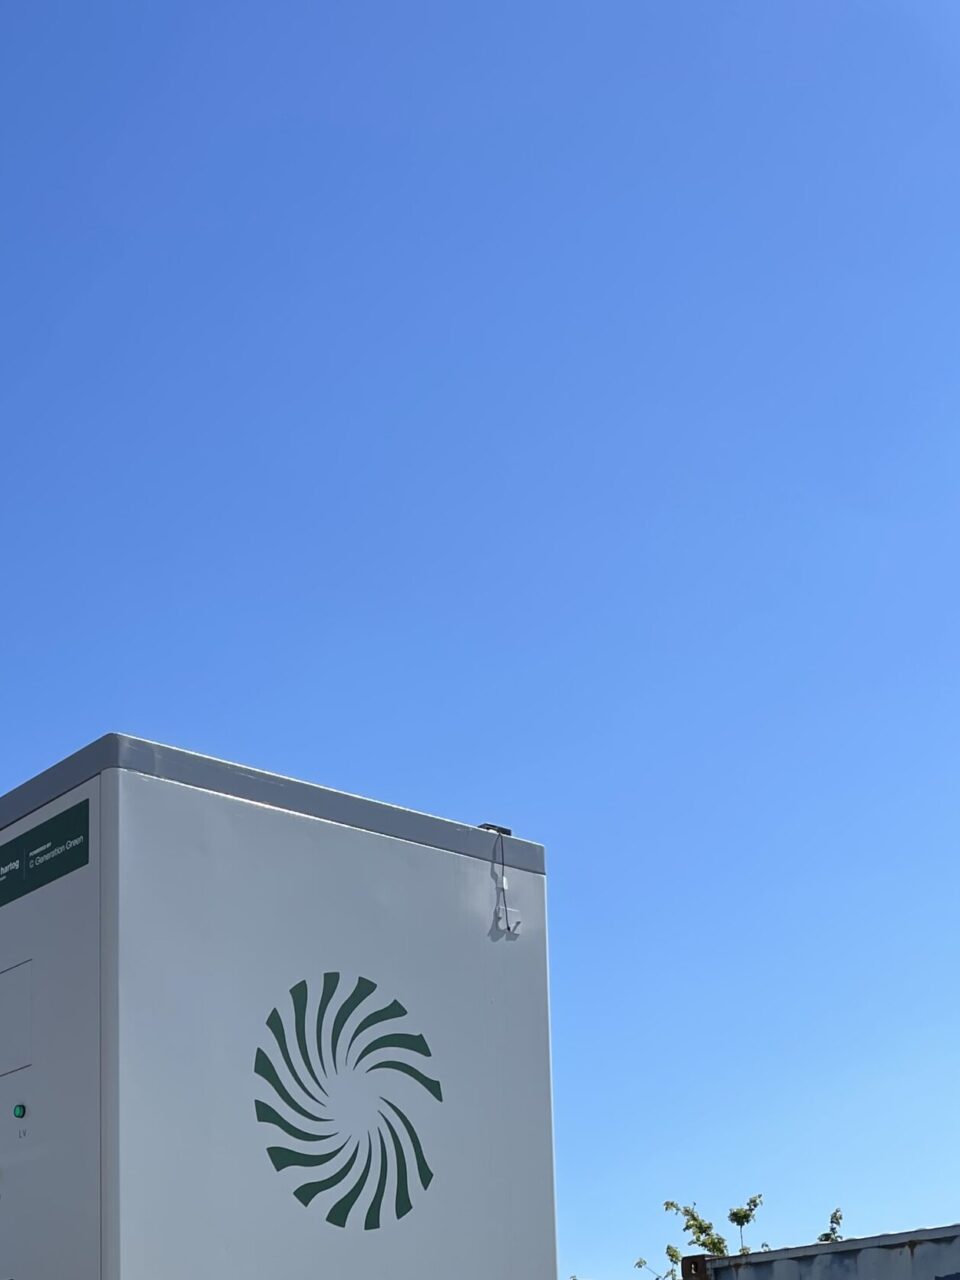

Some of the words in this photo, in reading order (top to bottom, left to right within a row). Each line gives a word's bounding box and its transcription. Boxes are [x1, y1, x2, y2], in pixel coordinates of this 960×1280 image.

[34, 845, 65, 866] Generation
[65, 835, 84, 850] Green
[0, 859, 20, 875] hartog
